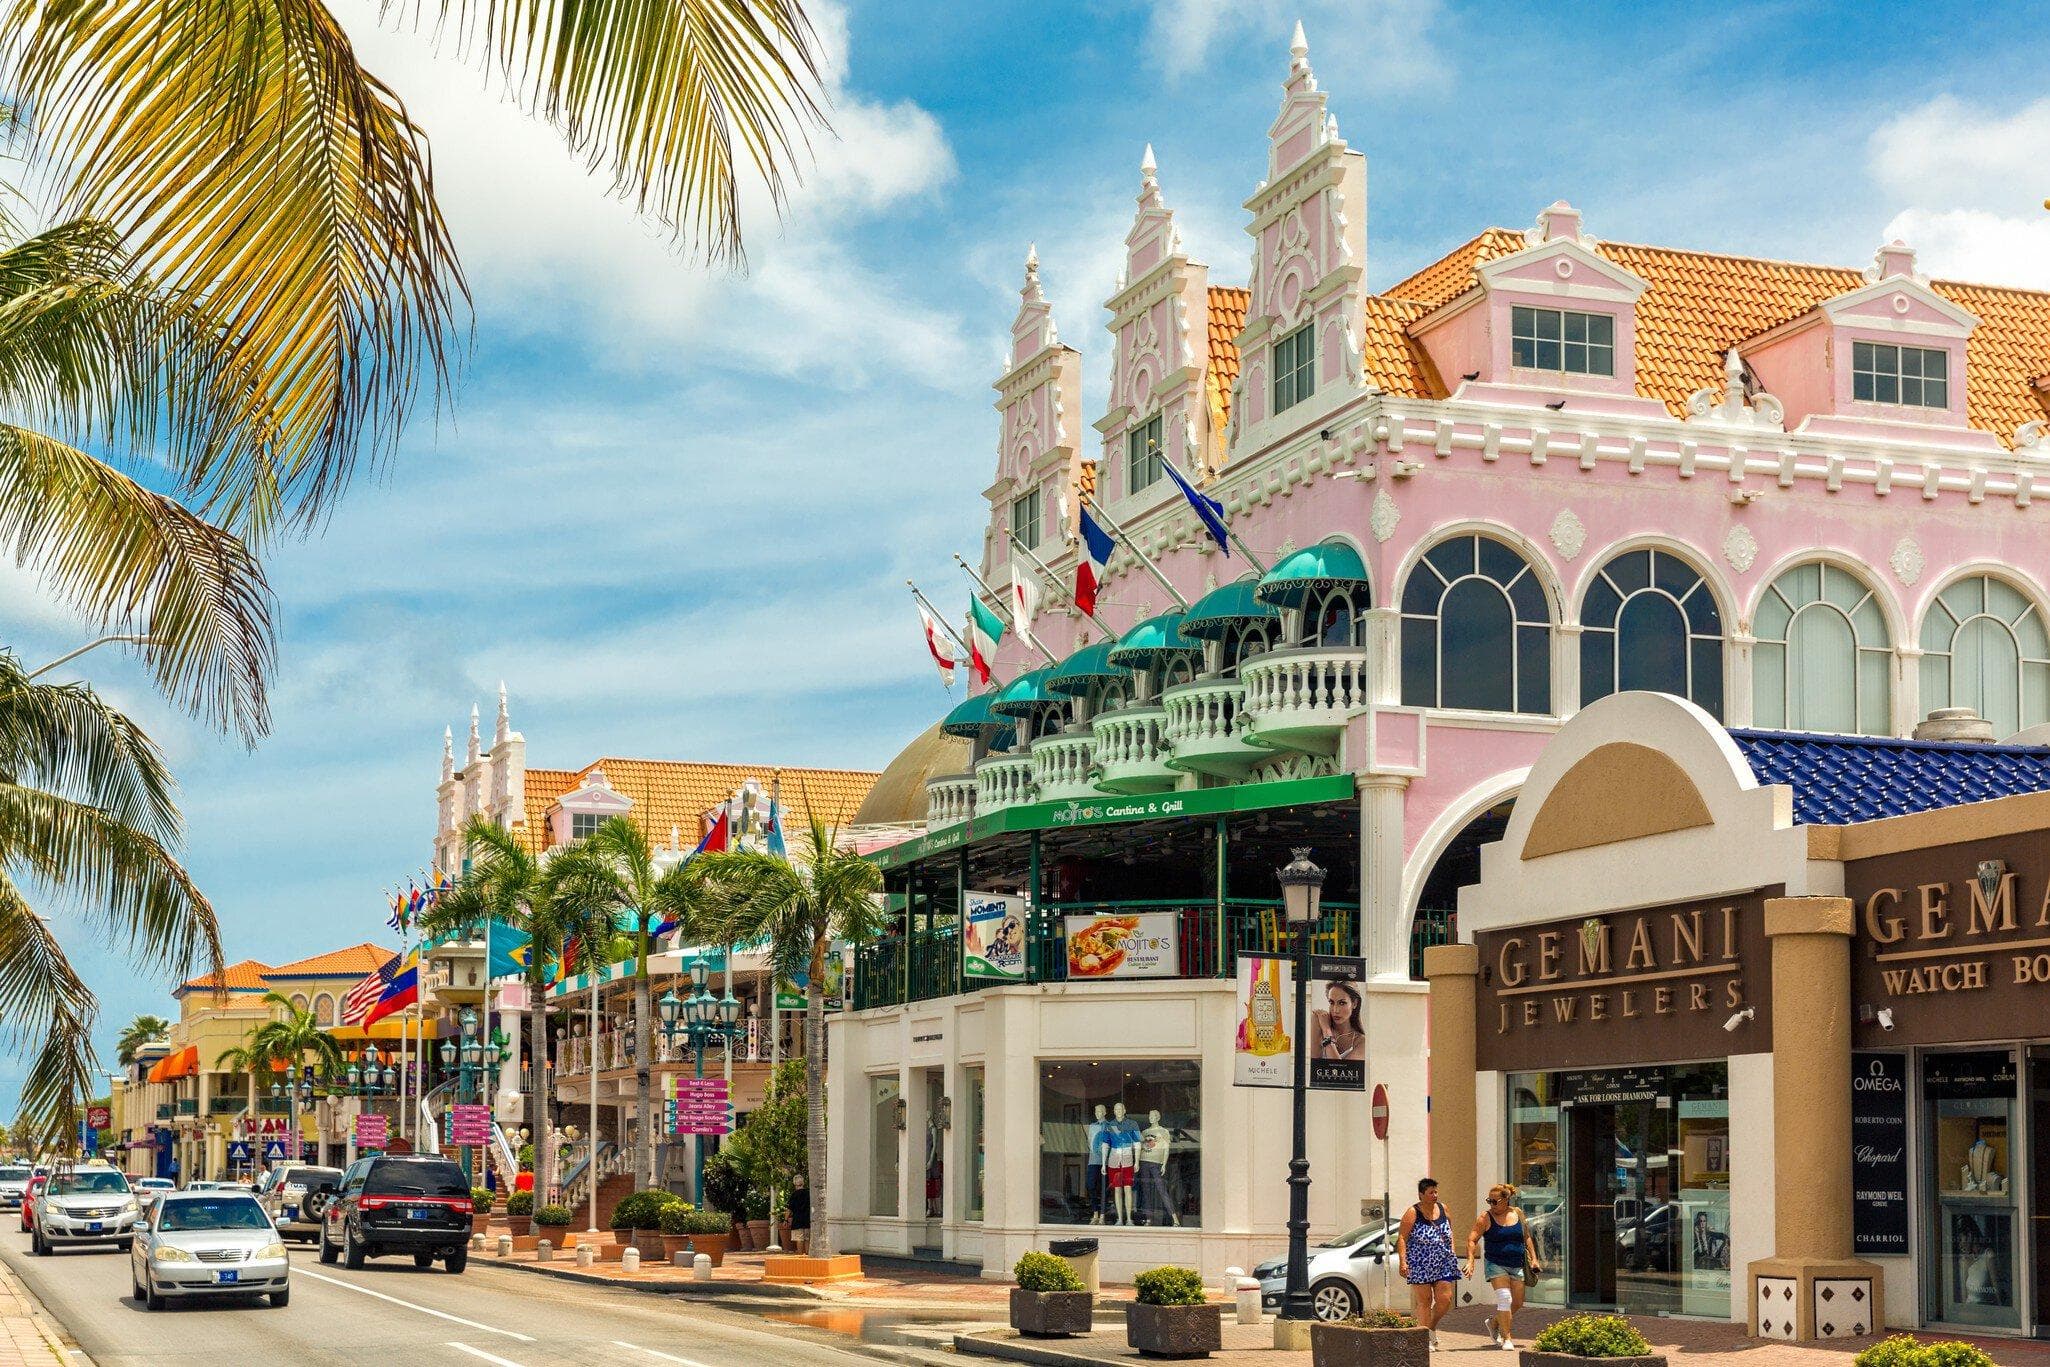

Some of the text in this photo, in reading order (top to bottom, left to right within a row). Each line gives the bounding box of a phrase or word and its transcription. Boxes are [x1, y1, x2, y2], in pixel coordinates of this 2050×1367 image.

[1106, 805, 1144, 817] Cantina
[1148, 802, 1157, 813] &
[1162, 800, 1183, 814] Grill
[971, 901, 1006, 916] MOMENTS
[1499, 907, 1739, 987] GEMANI
[1881, 961, 1986, 996] WATCH
[1497, 979, 1742, 1035] JEWELERS
[1854, 1077, 1902, 1091] OMEGA
[1589, 1094, 1602, 1103] FOR
[1602, 1092, 1622, 1102] LOOSE
[1854, 1116, 1903, 1124] ROBERTO COIN
[1854, 1145, 1902, 1168] Chopard
[1856, 1190, 1904, 1201] RAYMOND WEIL
[1856, 1234, 1905, 1243] CHARRIOL
